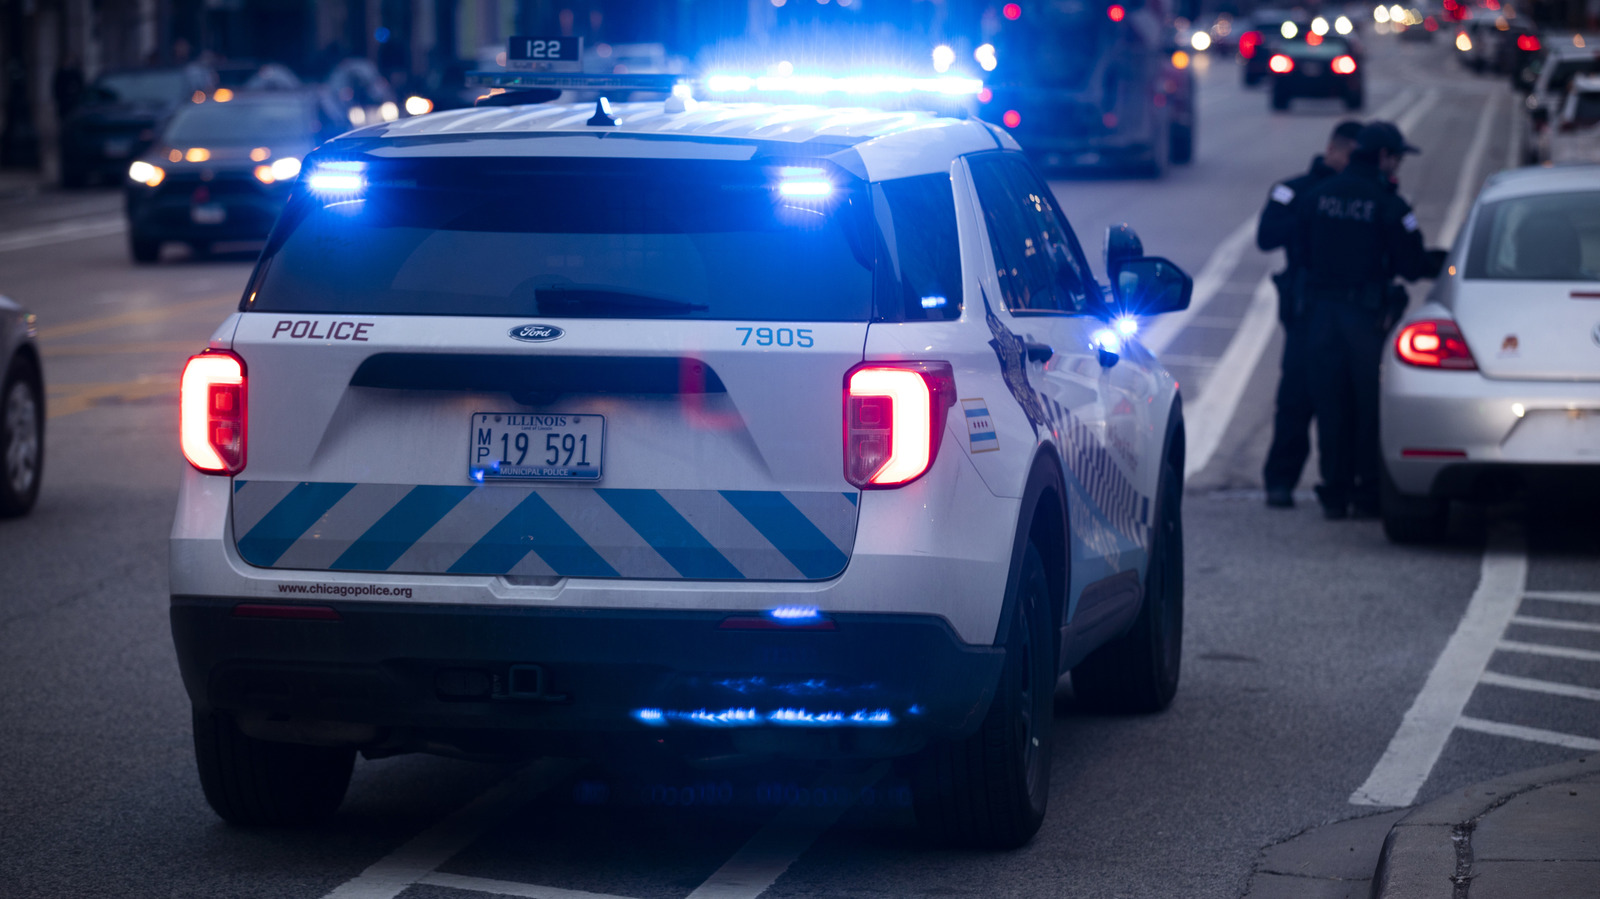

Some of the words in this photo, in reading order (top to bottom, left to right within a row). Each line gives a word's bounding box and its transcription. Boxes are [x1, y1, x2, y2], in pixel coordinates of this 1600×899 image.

[526, 40, 561, 58] 122
[1318, 195, 1375, 221] POLICE
[271, 320, 375, 342] POLICE
[519, 326, 552, 337] Ford
[735, 327, 814, 348] 7905
[506, 415, 567, 427] ILLINOIS
[498, 432, 529, 466] 19
[545, 433, 591, 467] 591
[500, 468, 541, 476] MUNICIPAL
[543, 468, 569, 476] POLICE
[278, 583, 413, 599] www.chicagopolice.org
